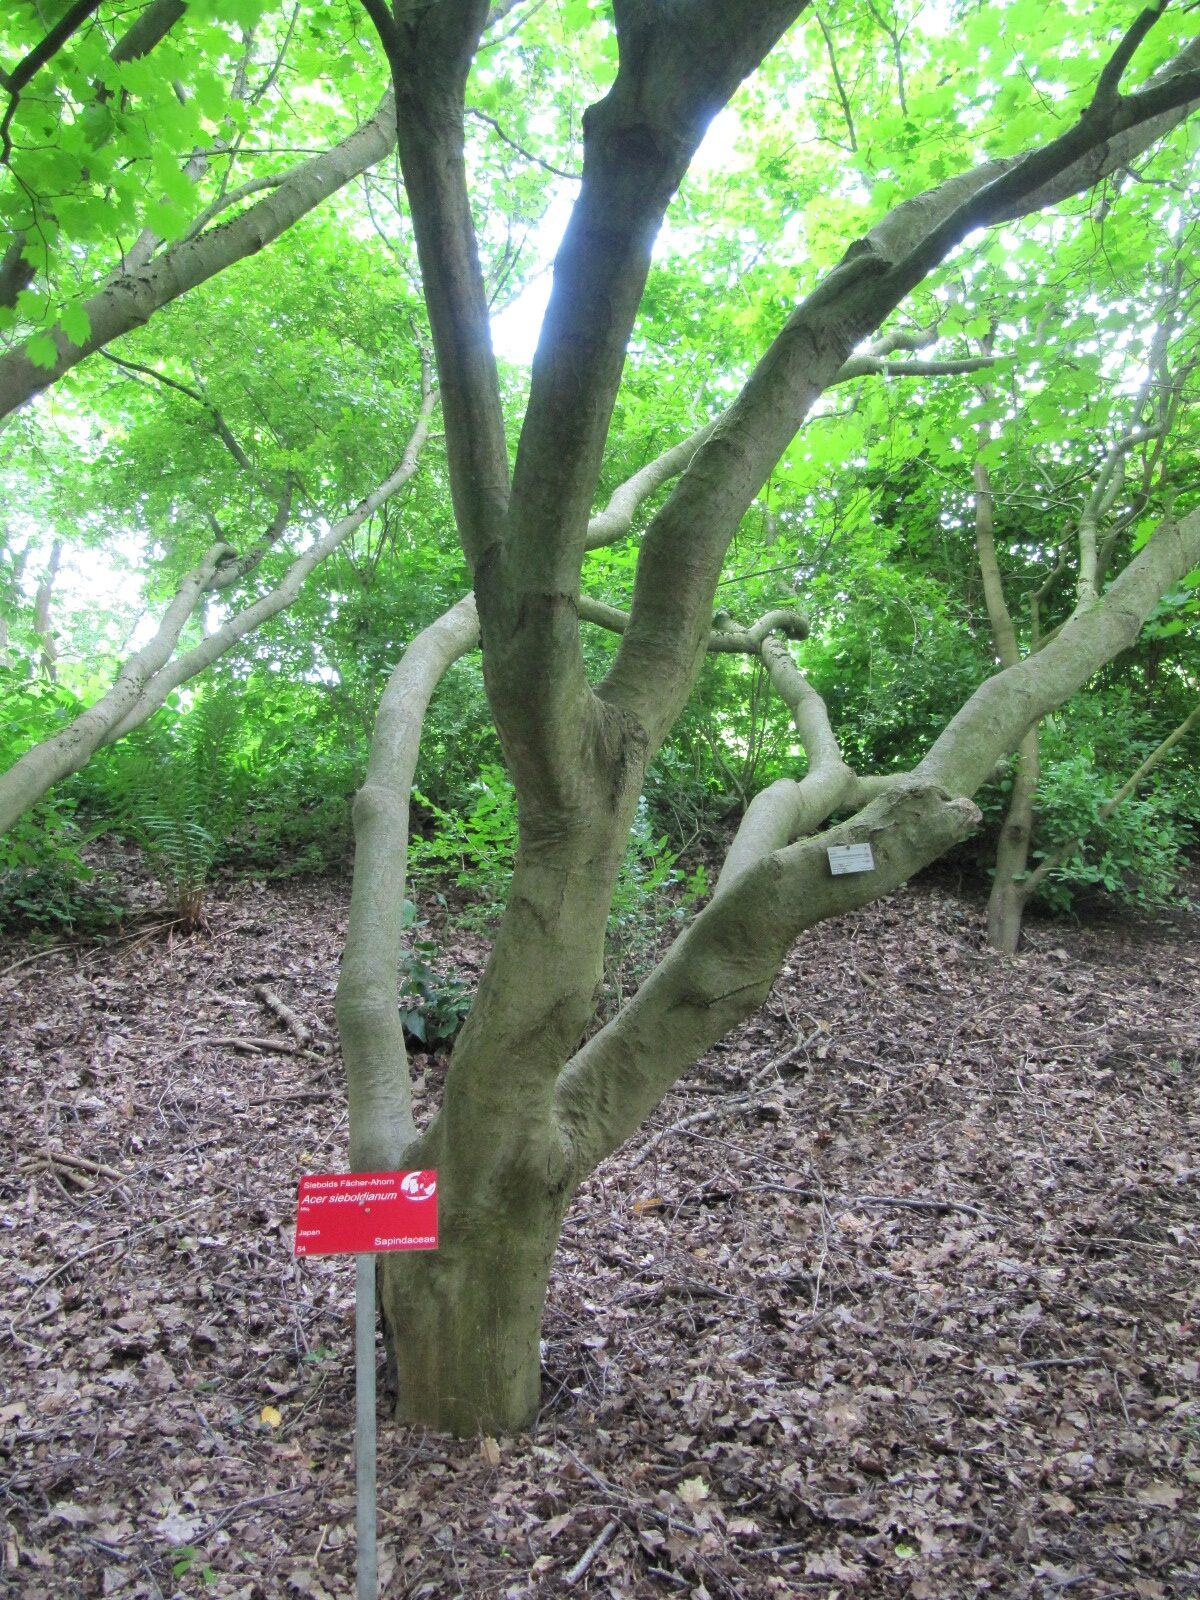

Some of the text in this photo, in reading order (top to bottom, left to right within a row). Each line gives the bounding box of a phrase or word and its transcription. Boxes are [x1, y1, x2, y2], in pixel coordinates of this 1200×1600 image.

[304, 1178, 395, 1189] Siebolds Fächer-Ahorn
[301, 1191, 397, 1204] Acer sieboldianum
[298, 1229, 320, 1237] Japan
[374, 1236, 435, 1246] Sapindaceae
